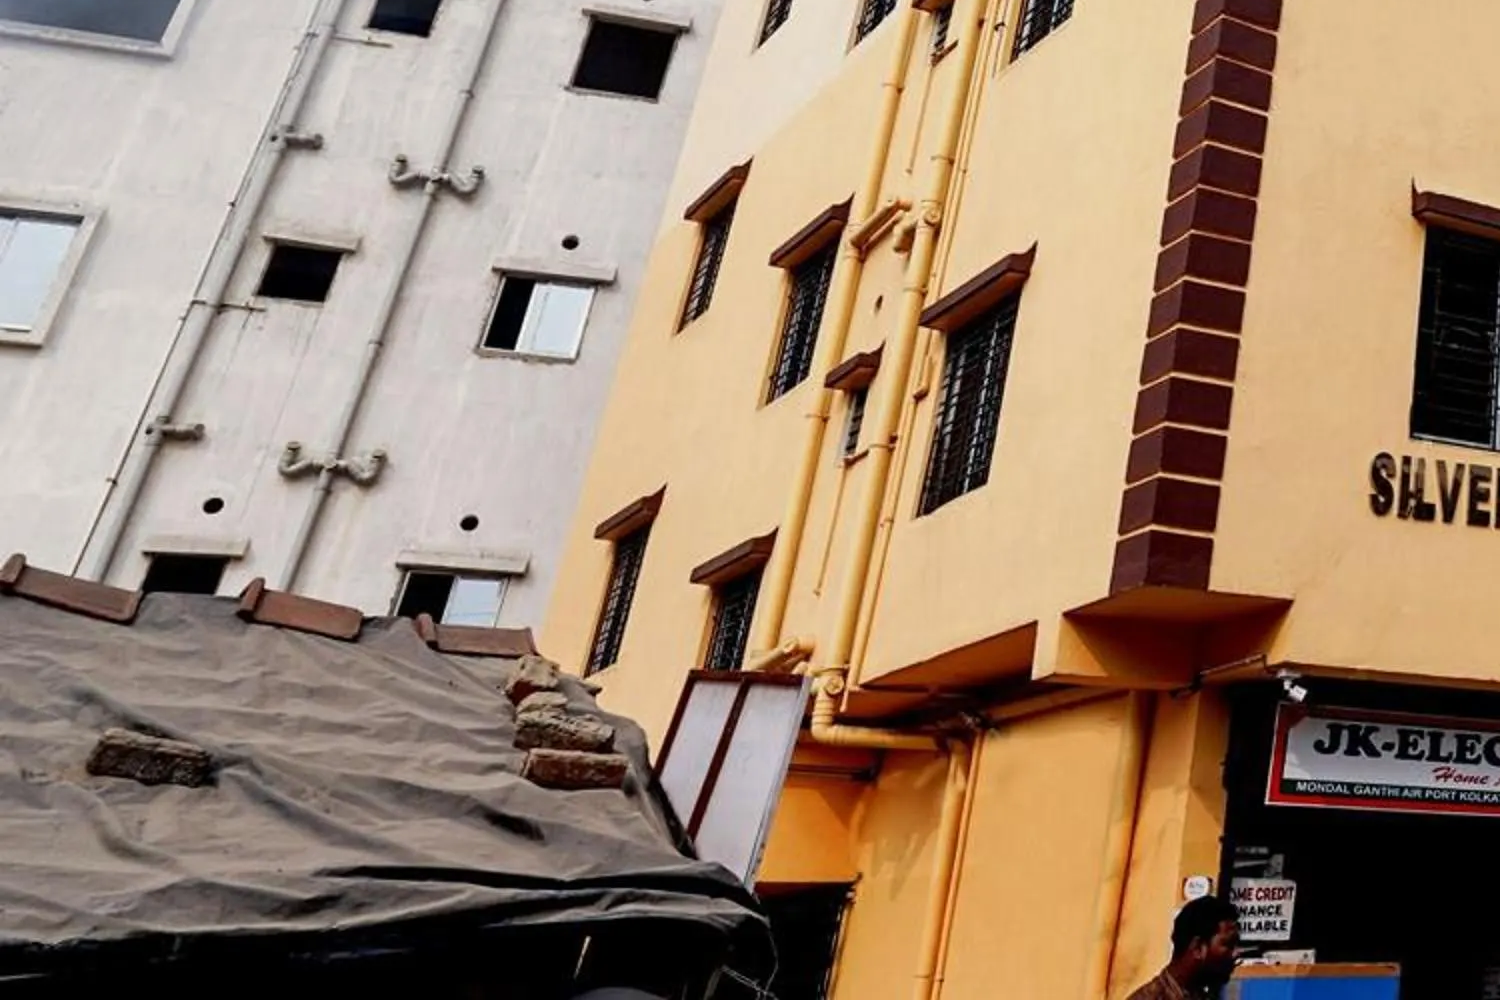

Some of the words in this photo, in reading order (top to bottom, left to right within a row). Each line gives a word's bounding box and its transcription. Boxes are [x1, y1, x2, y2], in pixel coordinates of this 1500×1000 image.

[1431, 766, 1490, 785] Home
[1296, 782, 1350, 794] MONDAL
[1402, 788, 1421, 798] AIR
[1425, 789, 1456, 801] PORT
[1229, 887, 1253, 900] OME
[1255, 887, 1294, 901] CREDIT
[1239, 904, 1283, 917] NANCE
[1239, 920, 1288, 931] ILABLE
